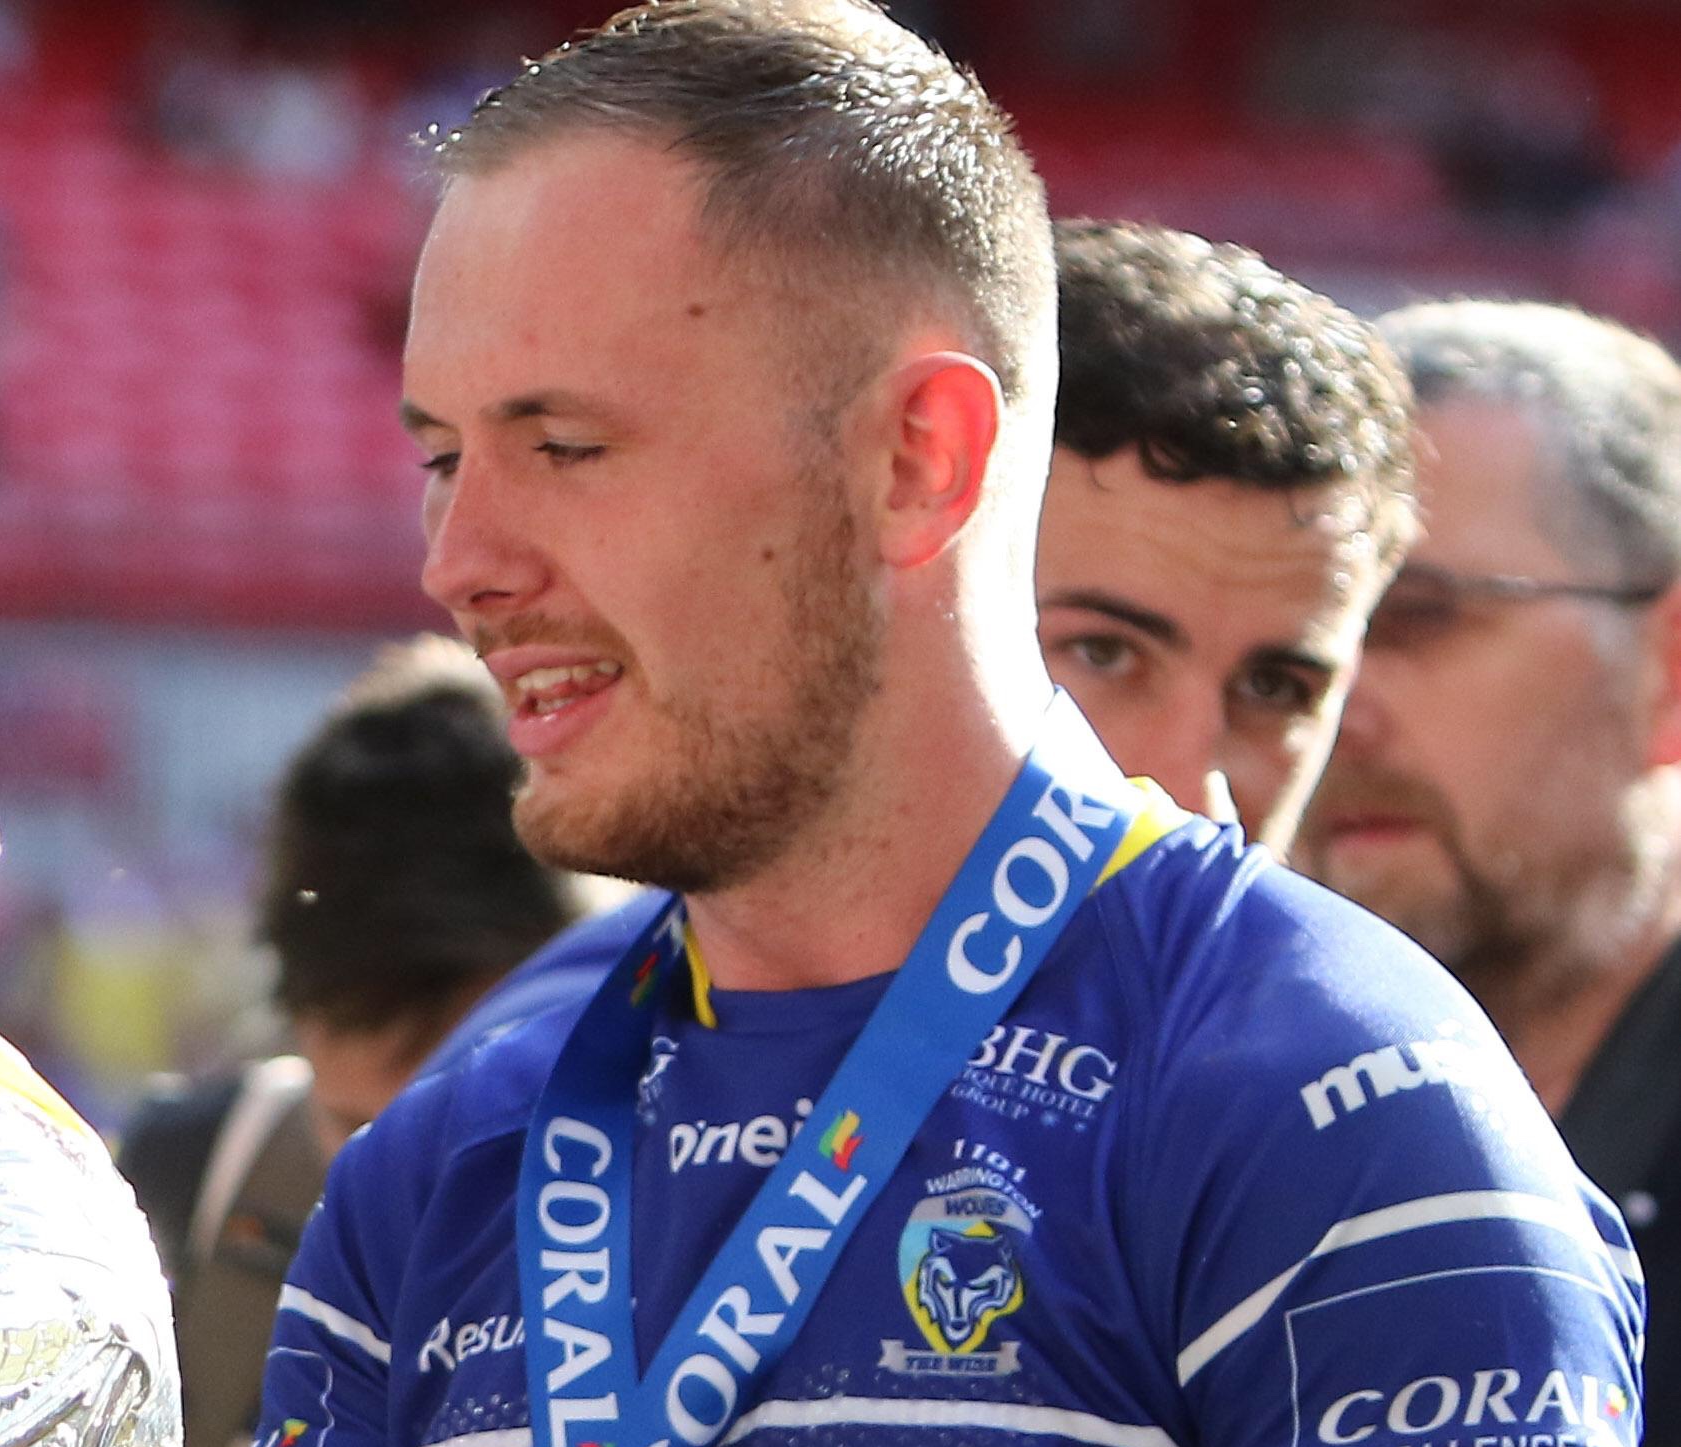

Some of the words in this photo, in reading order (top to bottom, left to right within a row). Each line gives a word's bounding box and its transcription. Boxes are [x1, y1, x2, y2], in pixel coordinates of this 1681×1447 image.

[954, 1138, 1027, 1183] 1101
[925, 1166, 1043, 1219] WARRINGTON
[1316, 1367, 1607, 1446] CORAL
